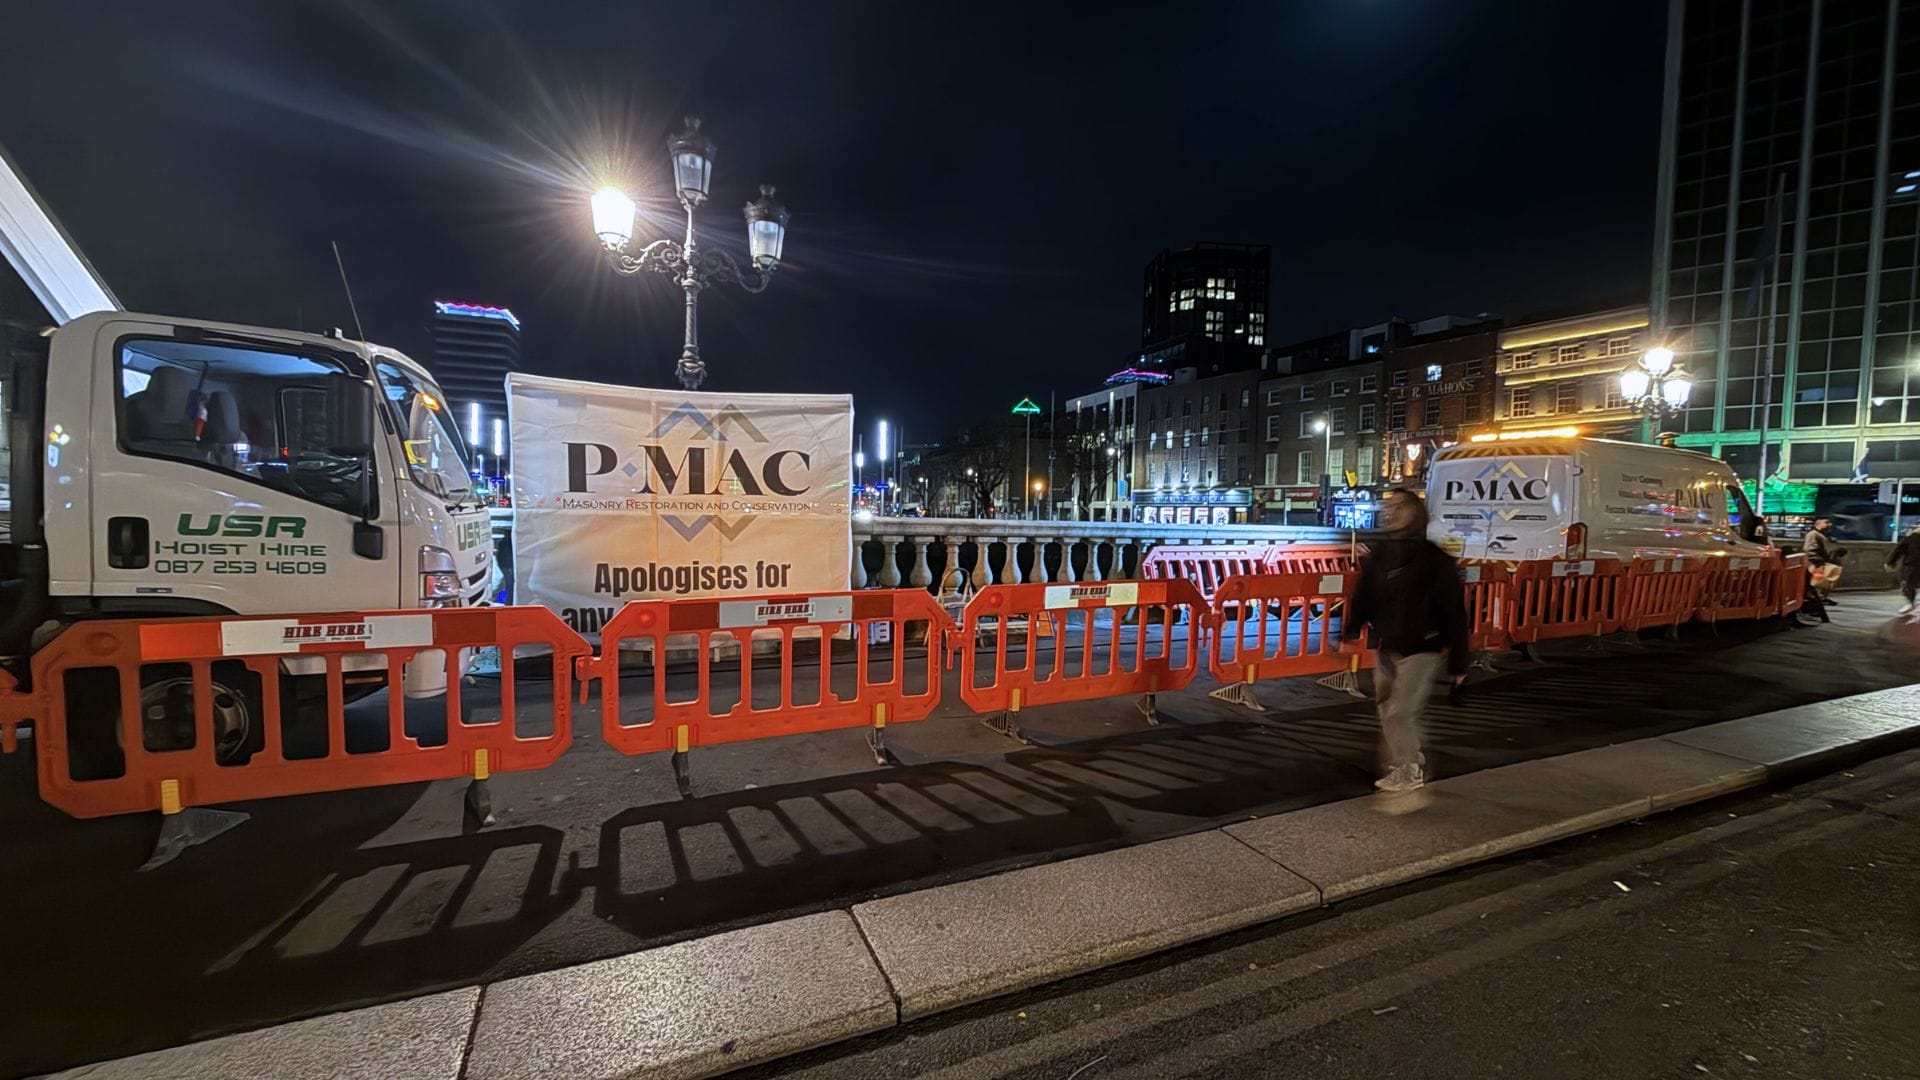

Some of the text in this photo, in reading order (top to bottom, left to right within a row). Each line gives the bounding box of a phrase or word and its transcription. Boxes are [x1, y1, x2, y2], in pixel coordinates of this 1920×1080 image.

[562, 498, 811, 512] MASONRY RESTORATION AND CONSERVATION
[177, 513, 307, 539] USR
[457, 521, 481, 552] USR
[155, 541, 327, 557] HOIST HIRE
[155, 560, 327, 575] 087 253 4609
[594, 560, 791, 597] Apologises for
[757, 606, 782, 616] HIRE
[284, 626, 322, 638] HIRE
[325, 624, 366, 636] HERE
